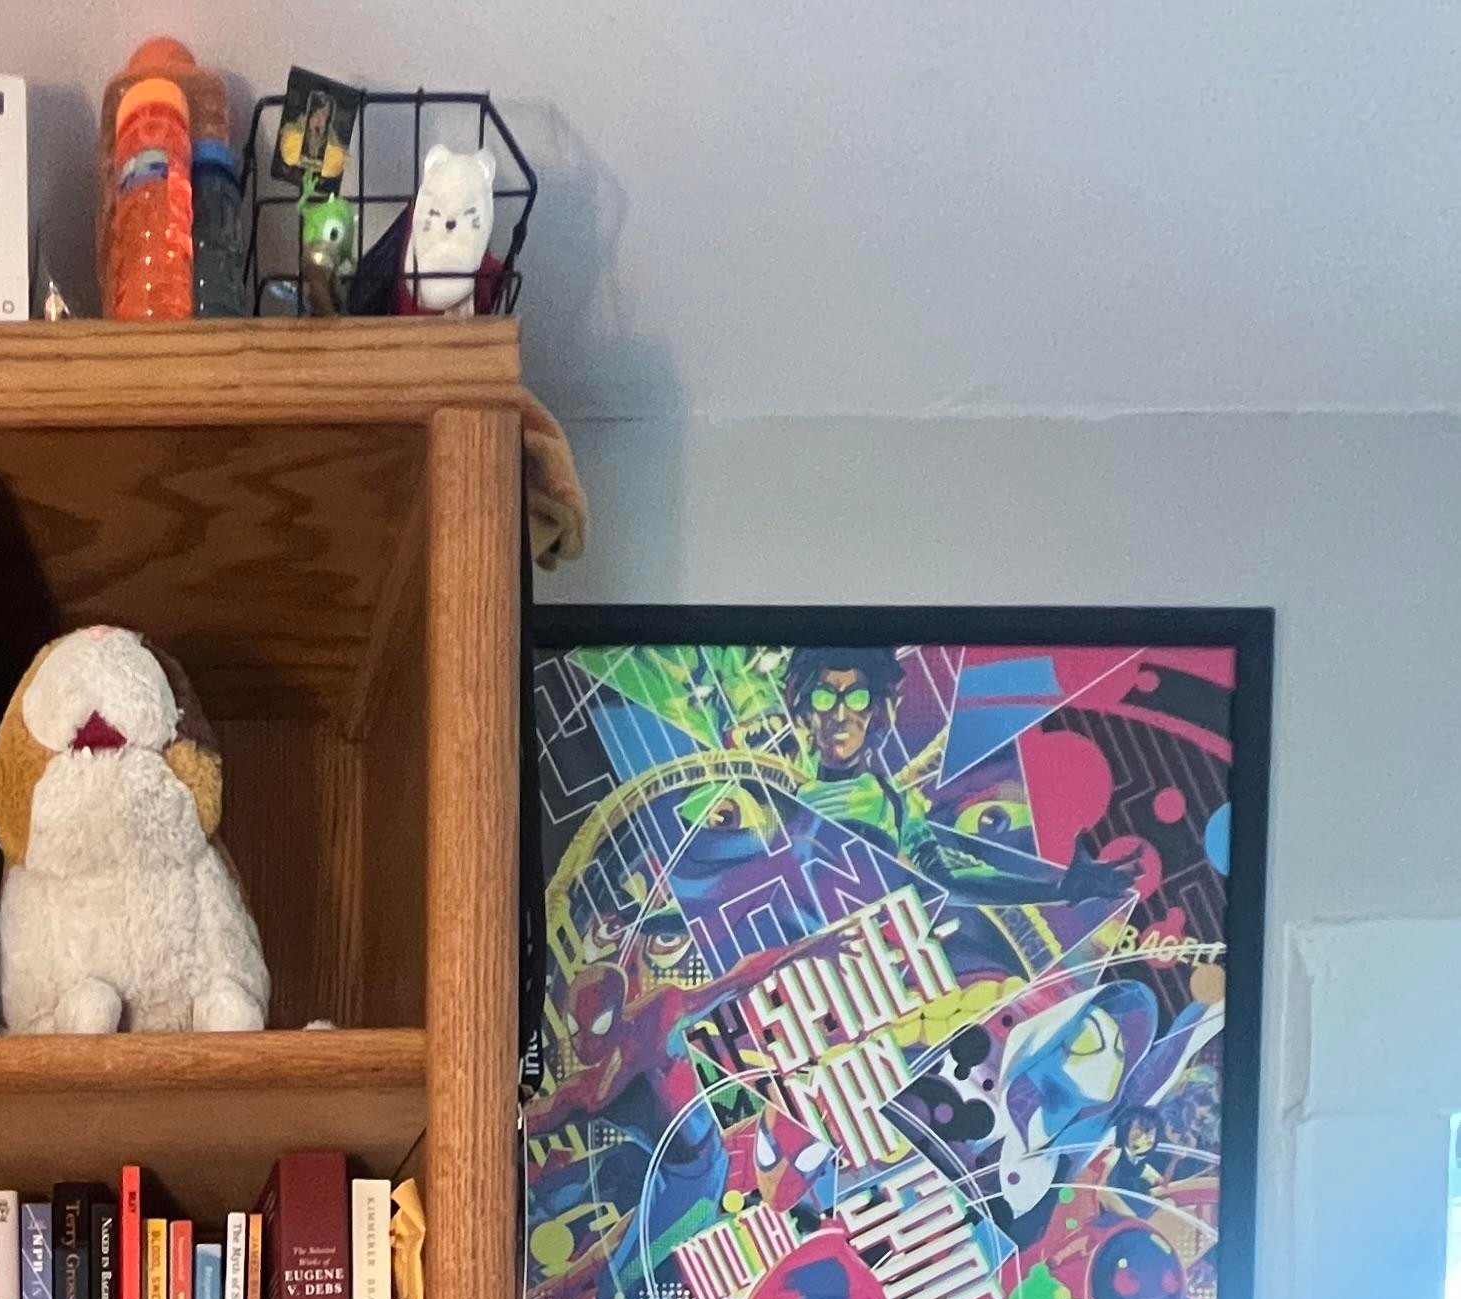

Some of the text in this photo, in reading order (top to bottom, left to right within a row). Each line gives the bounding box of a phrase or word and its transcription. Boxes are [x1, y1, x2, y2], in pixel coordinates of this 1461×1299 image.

[793, 1030, 914, 1172] MAN
[284, 1267, 345, 1282] EUGENE
[287, 1283, 343, 1296] V. DEBS
